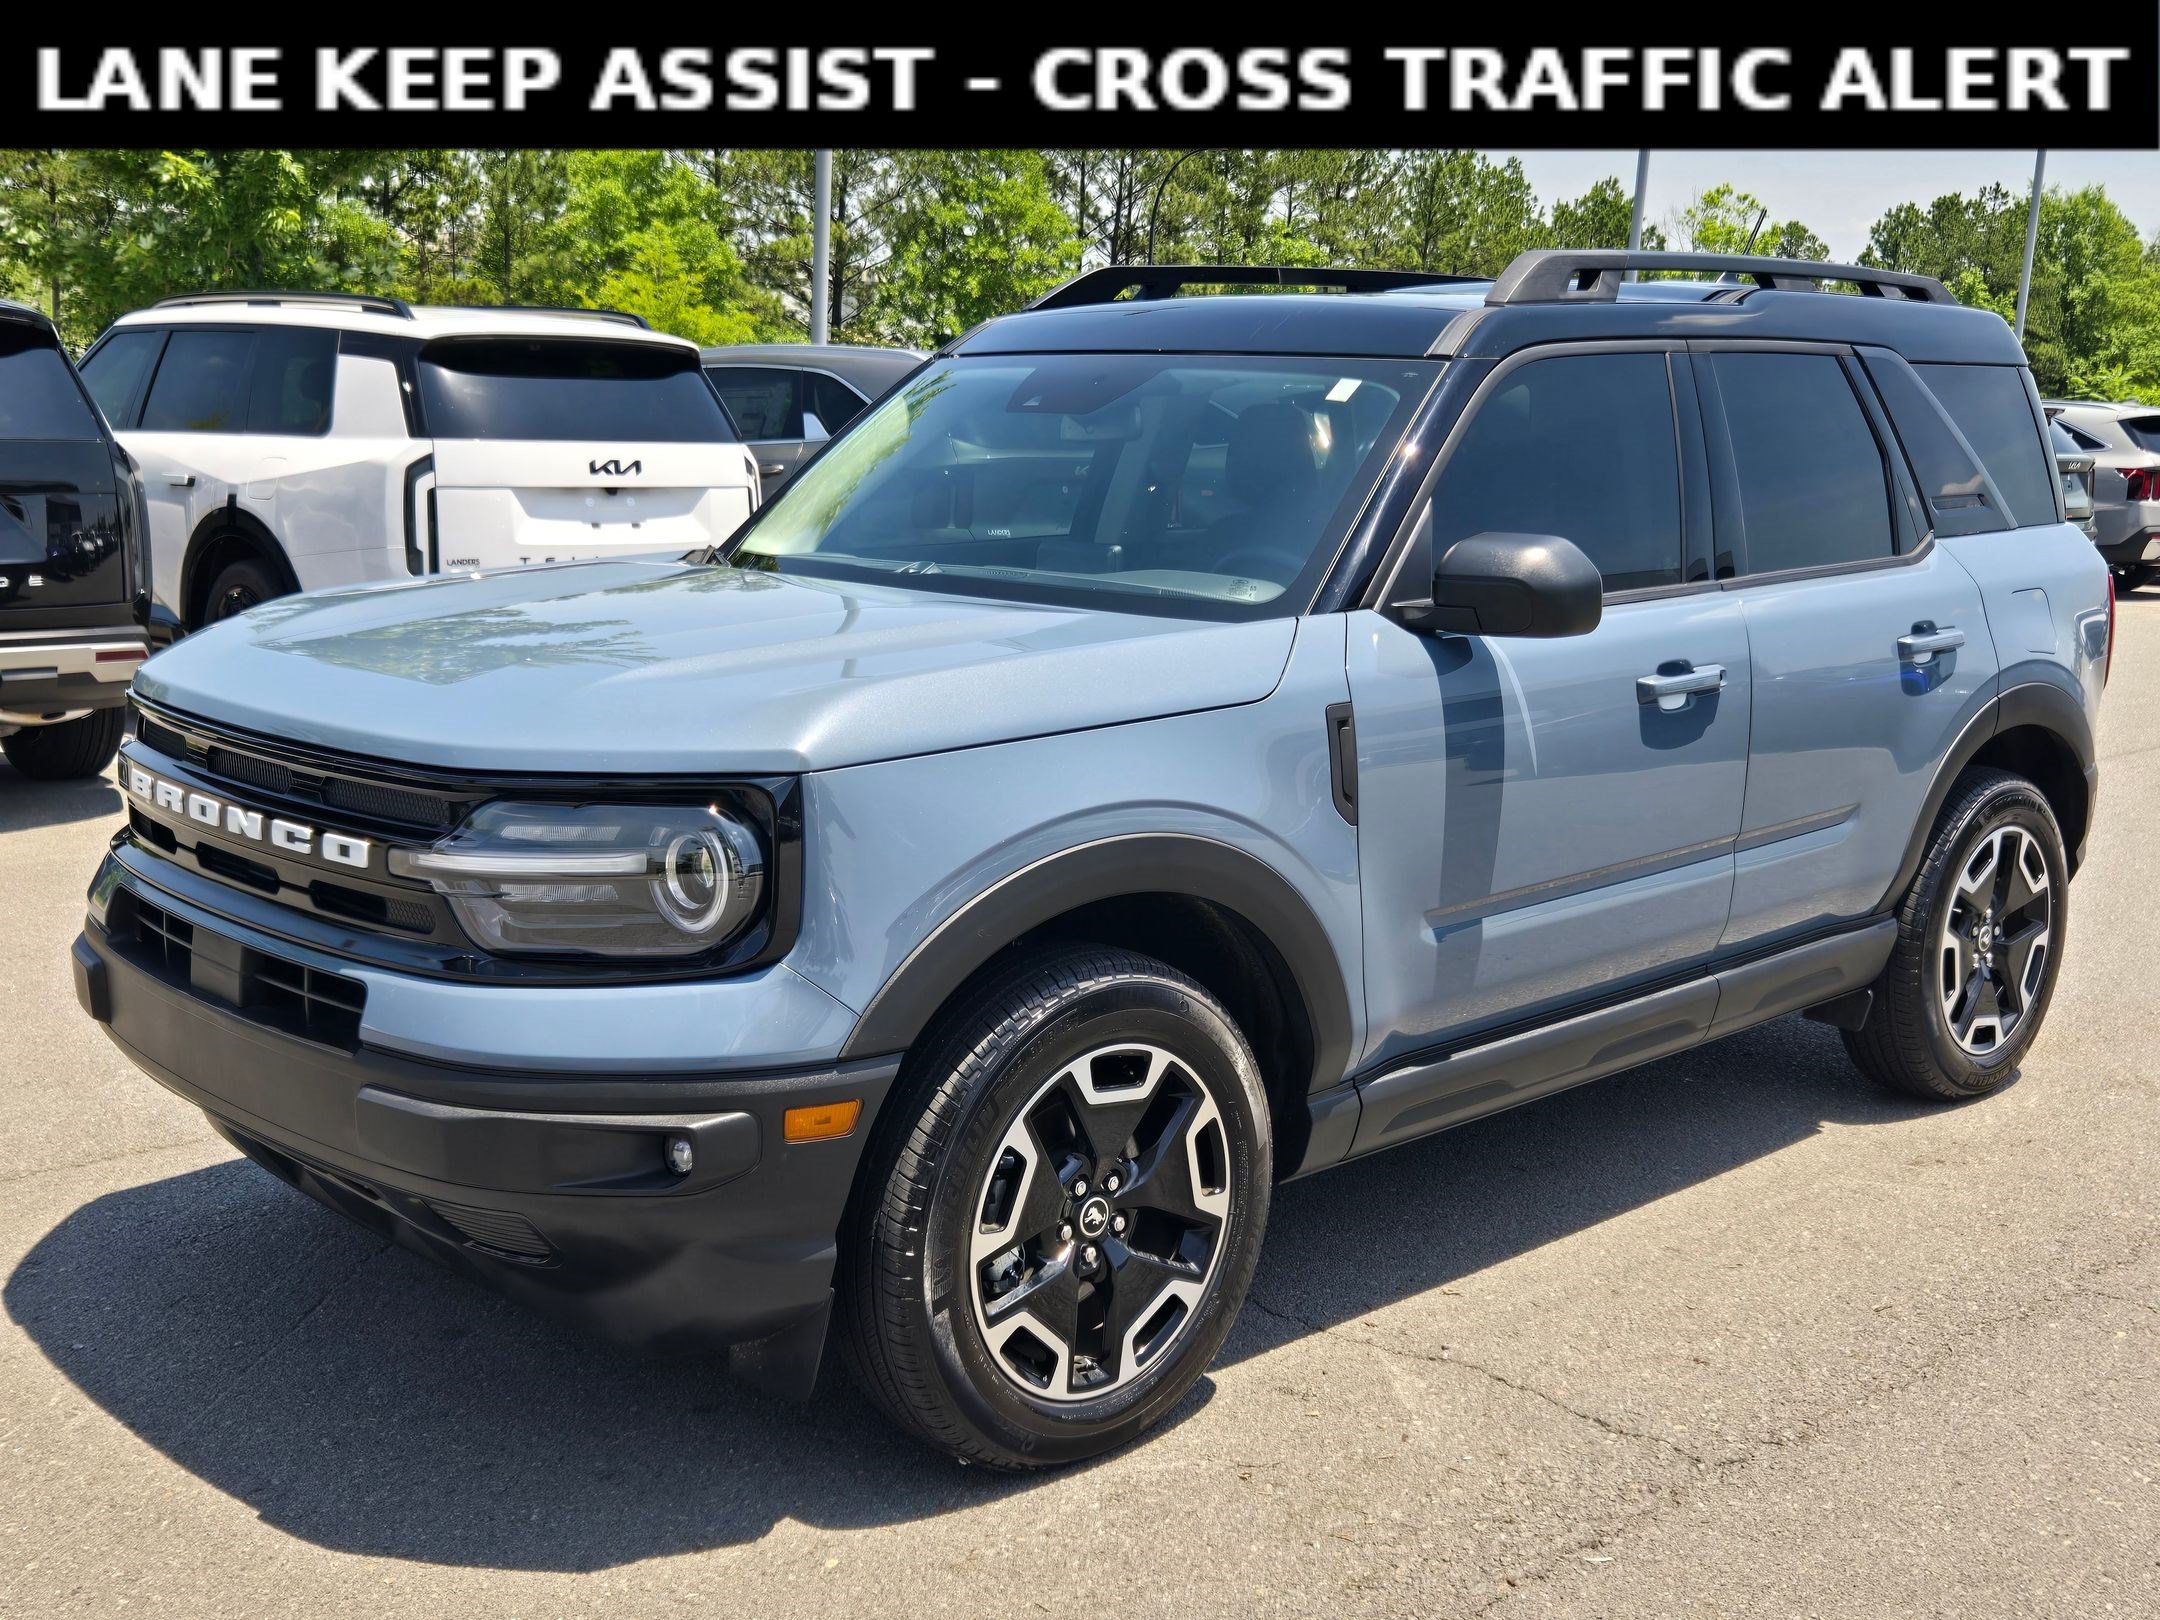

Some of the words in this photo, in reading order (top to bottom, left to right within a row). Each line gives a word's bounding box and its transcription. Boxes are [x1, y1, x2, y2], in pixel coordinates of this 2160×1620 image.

[589, 459, 642, 476] KIA
[446, 558, 481, 566] LANDERS
[131, 766, 371, 869] BRONCO
